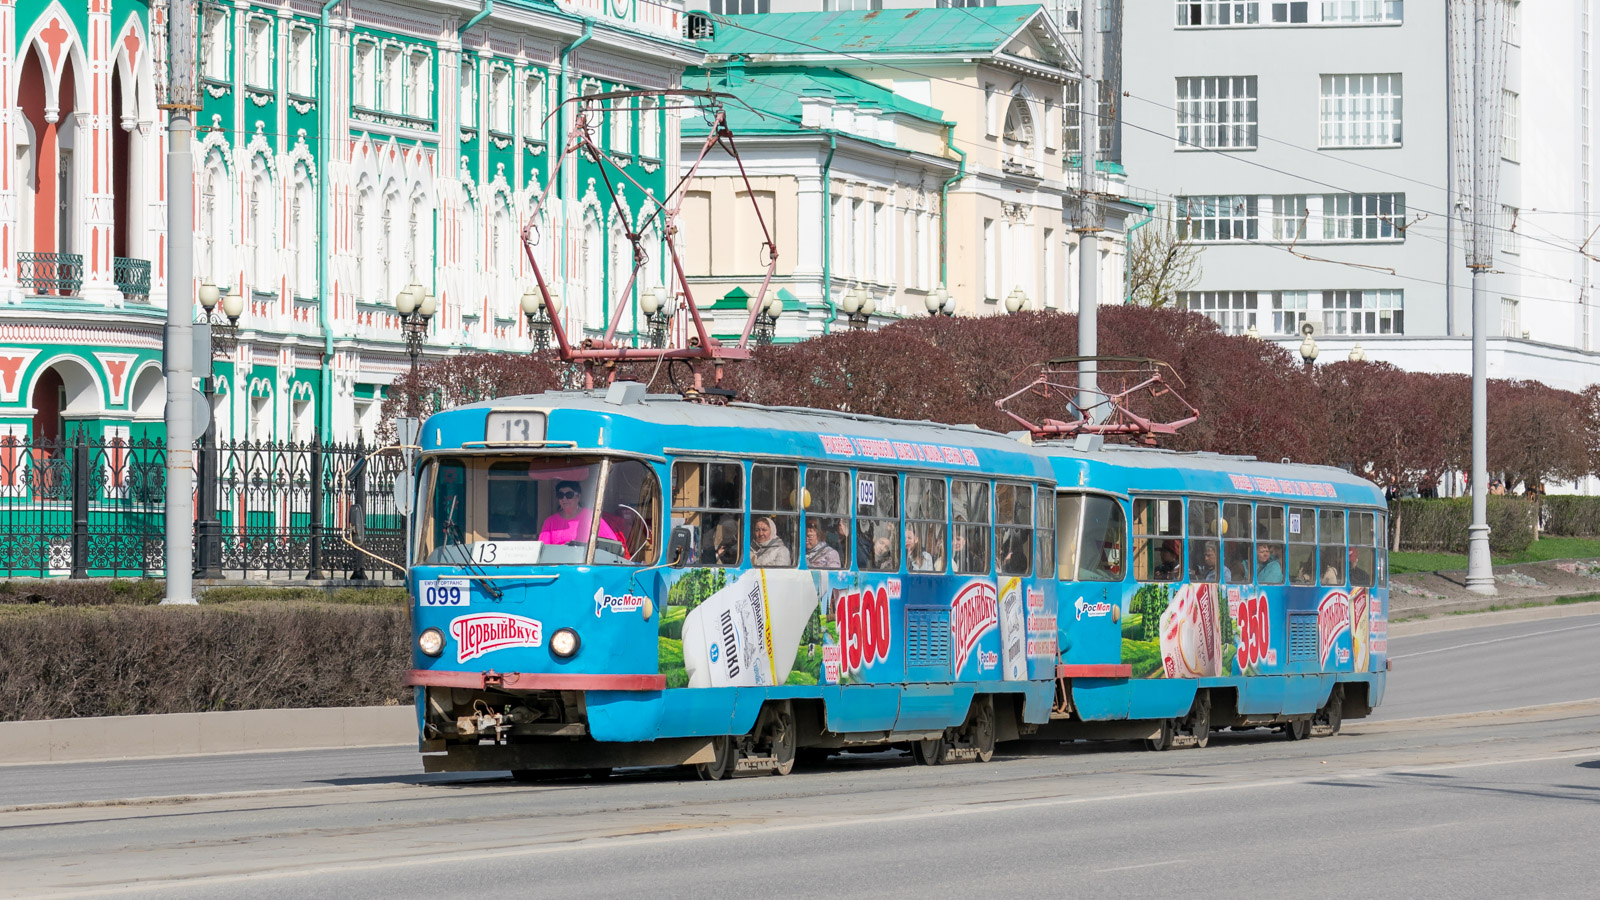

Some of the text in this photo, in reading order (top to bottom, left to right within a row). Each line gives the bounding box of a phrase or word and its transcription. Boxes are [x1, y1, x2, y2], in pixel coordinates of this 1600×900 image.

[502, 419, 530, 447] 13
[861, 481, 873, 503] 099
[479, 543, 497, 563] 13
[426, 586, 461, 605] 099
[603, 595, 642, 607] РосМол
[1082, 602, 1111, 612] РосМол
[836, 586, 890, 674] 1500
[1238, 595, 1269, 669] 350
